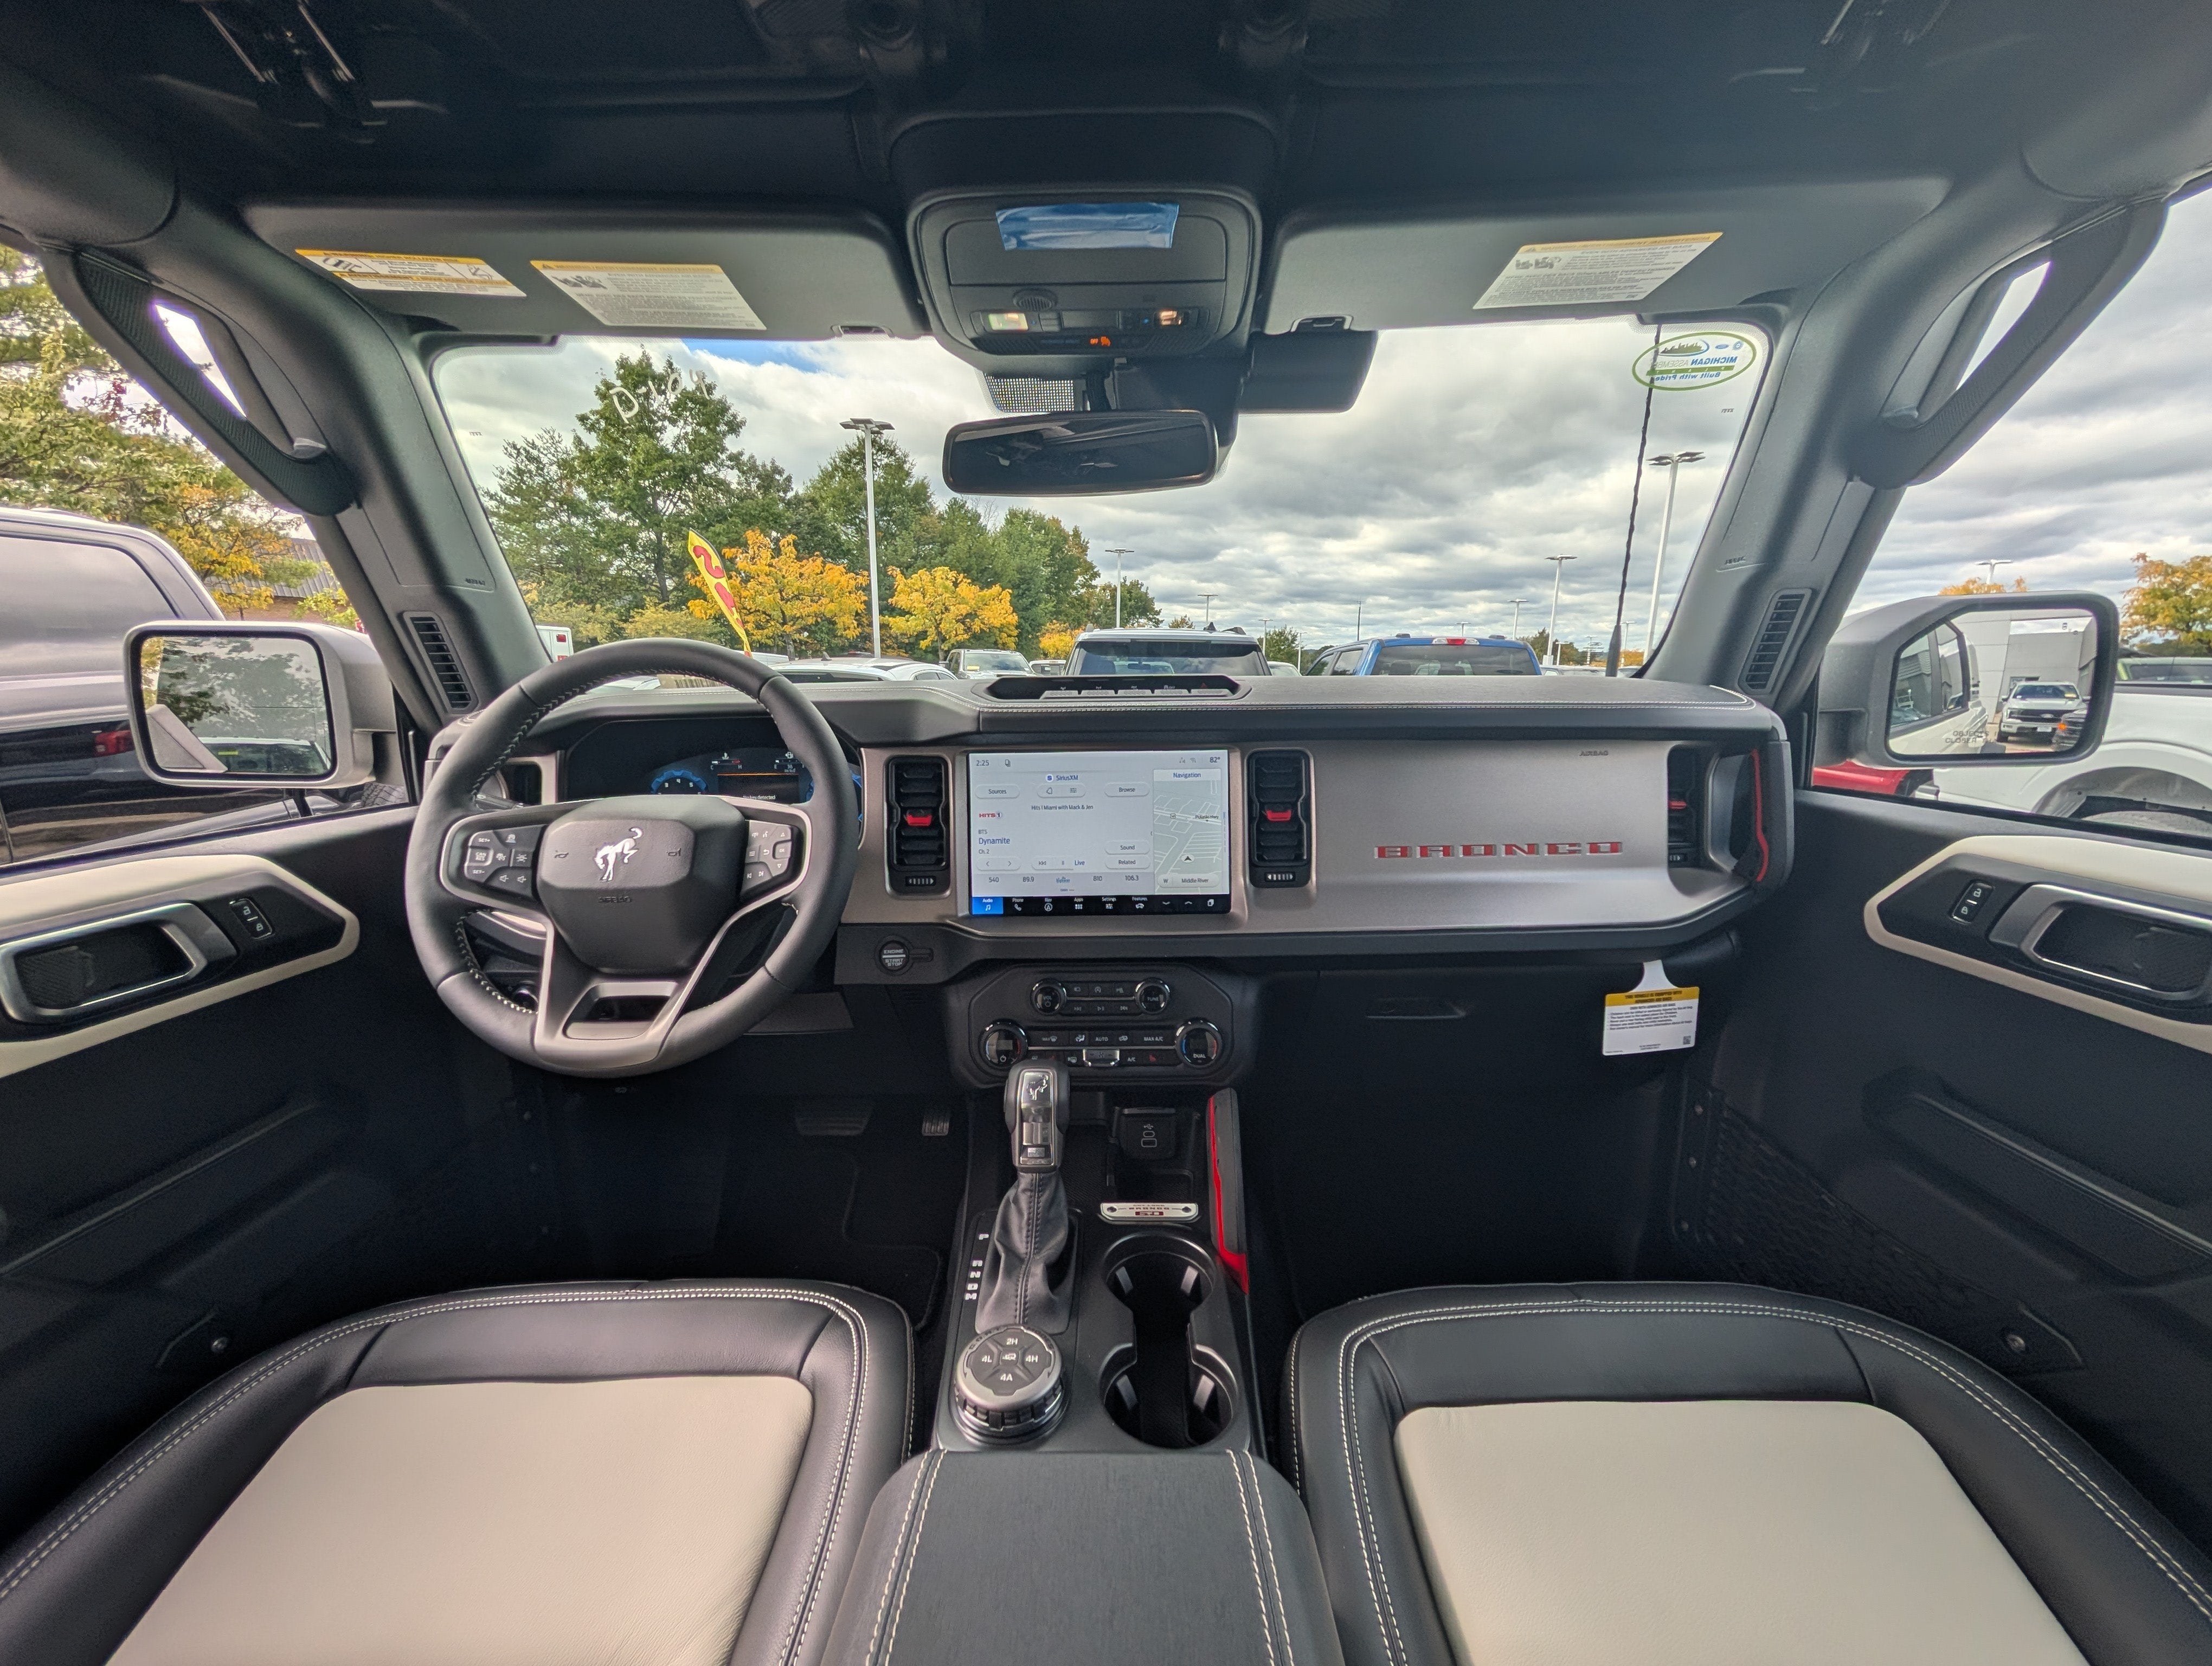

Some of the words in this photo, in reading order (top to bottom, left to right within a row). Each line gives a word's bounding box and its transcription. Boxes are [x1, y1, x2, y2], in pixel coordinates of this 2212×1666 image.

[979, 837, 1011, 845] Dynamite
[1374, 841, 1623, 859] BRONCO
[1006, 1337, 1018, 1345] 2H
[1025, 1355, 1038, 1363] 4H
[1000, 1373, 1013, 1381] 4A
